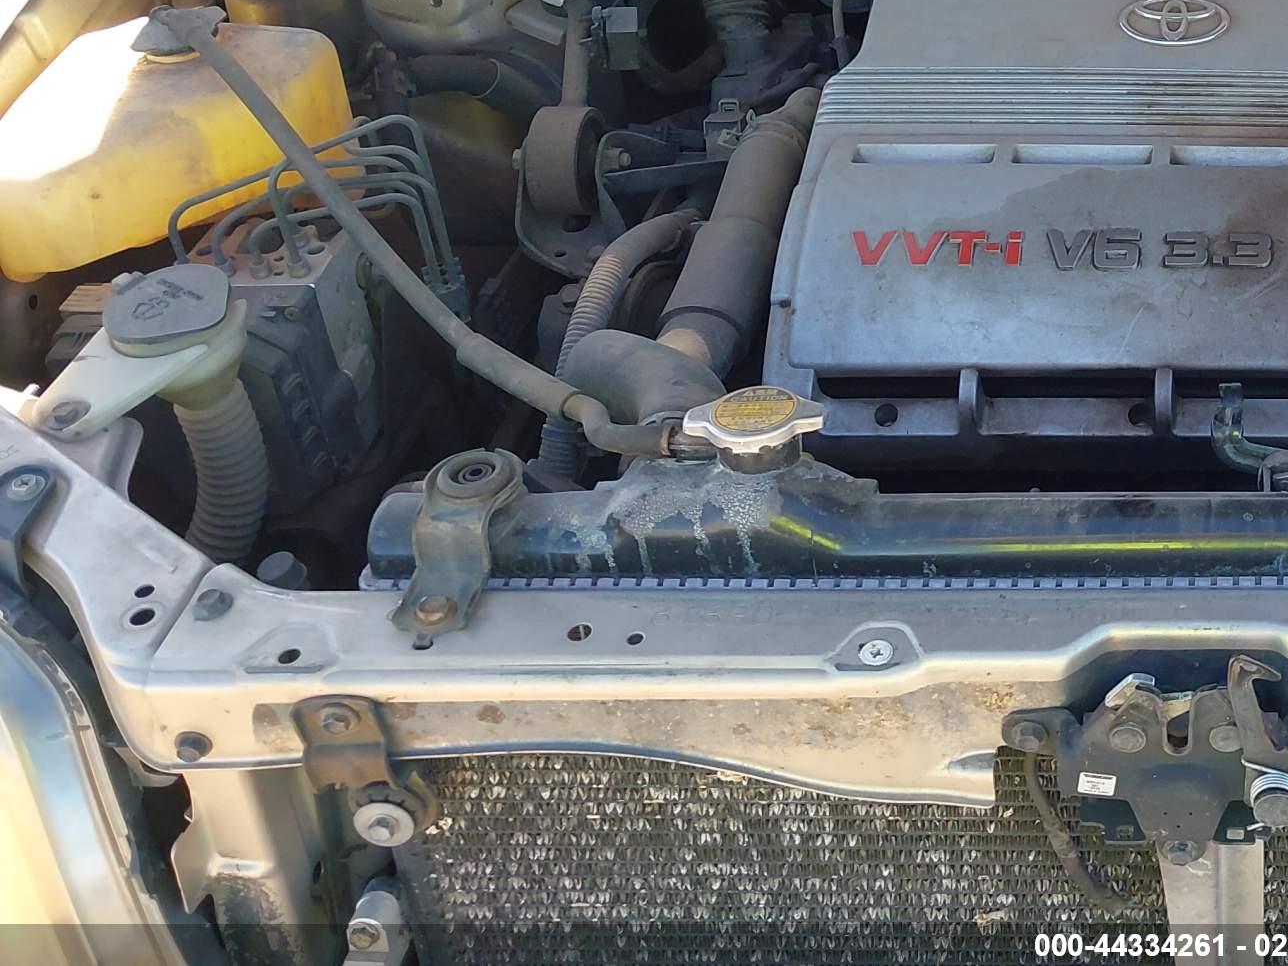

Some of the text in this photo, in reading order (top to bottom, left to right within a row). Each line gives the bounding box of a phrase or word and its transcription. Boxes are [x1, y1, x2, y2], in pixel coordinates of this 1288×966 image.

[852, 228, 1277, 271] VVT-i V6 3.3
